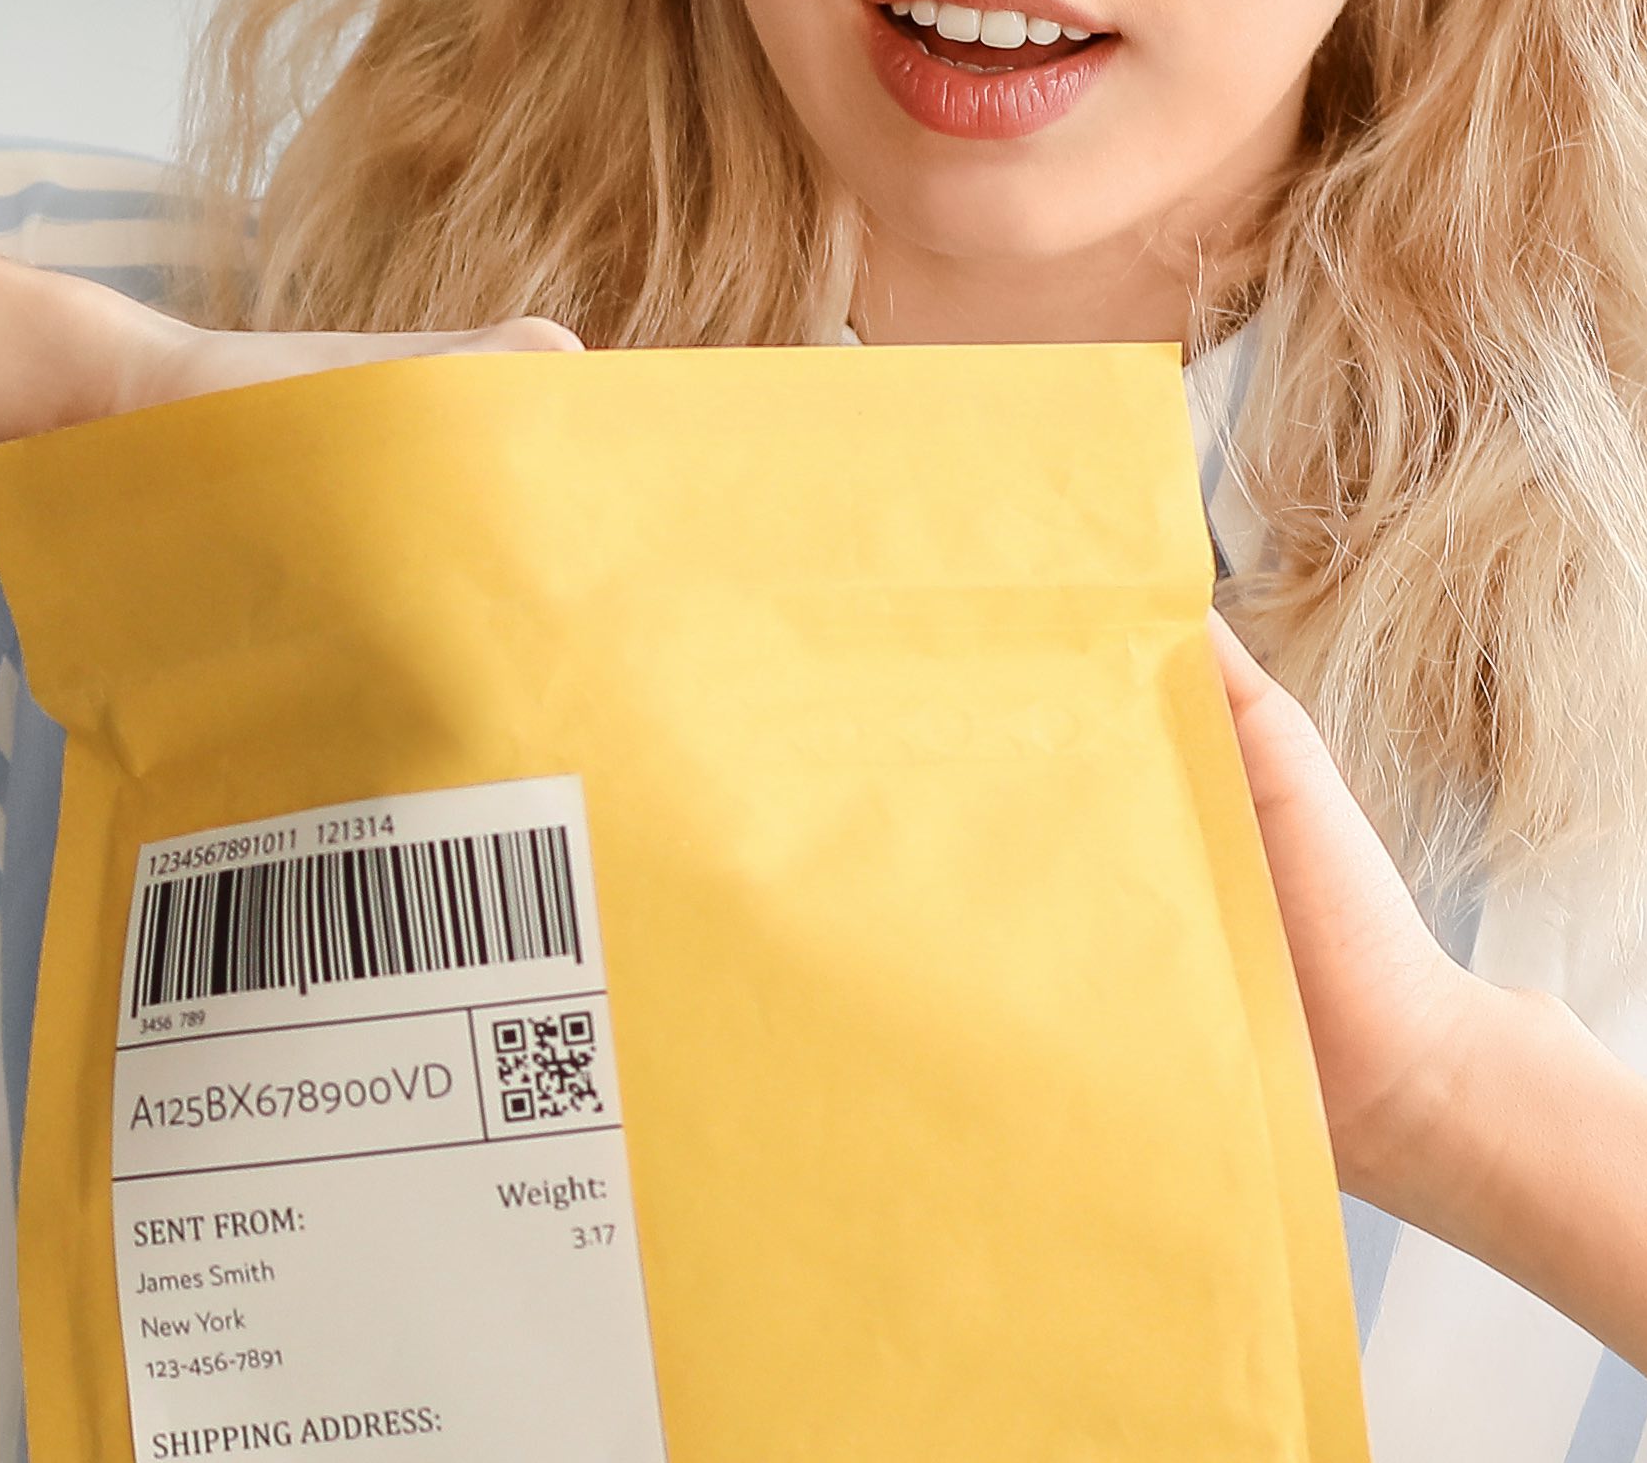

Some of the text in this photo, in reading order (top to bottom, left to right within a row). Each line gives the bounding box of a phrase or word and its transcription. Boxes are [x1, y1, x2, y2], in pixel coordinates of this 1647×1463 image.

[148, 814, 395, 876] 1234567891011 121314
[180, 1009, 206, 1027] 789
[130, 1063, 452, 1130] A125BX678900VD
[497, 1176, 606, 1210] Weight:
[134, 1207, 304, 1247] SENT FROM:
[571, 1224, 617, 1249] 3.17
[136, 1260, 275, 1294] James Smith
[141, 1308, 246, 1338] New York
[146, 1349, 282, 1379] 123-456-7891
[153, 1408, 441, 1459] SHIPPING ADDRESS:
